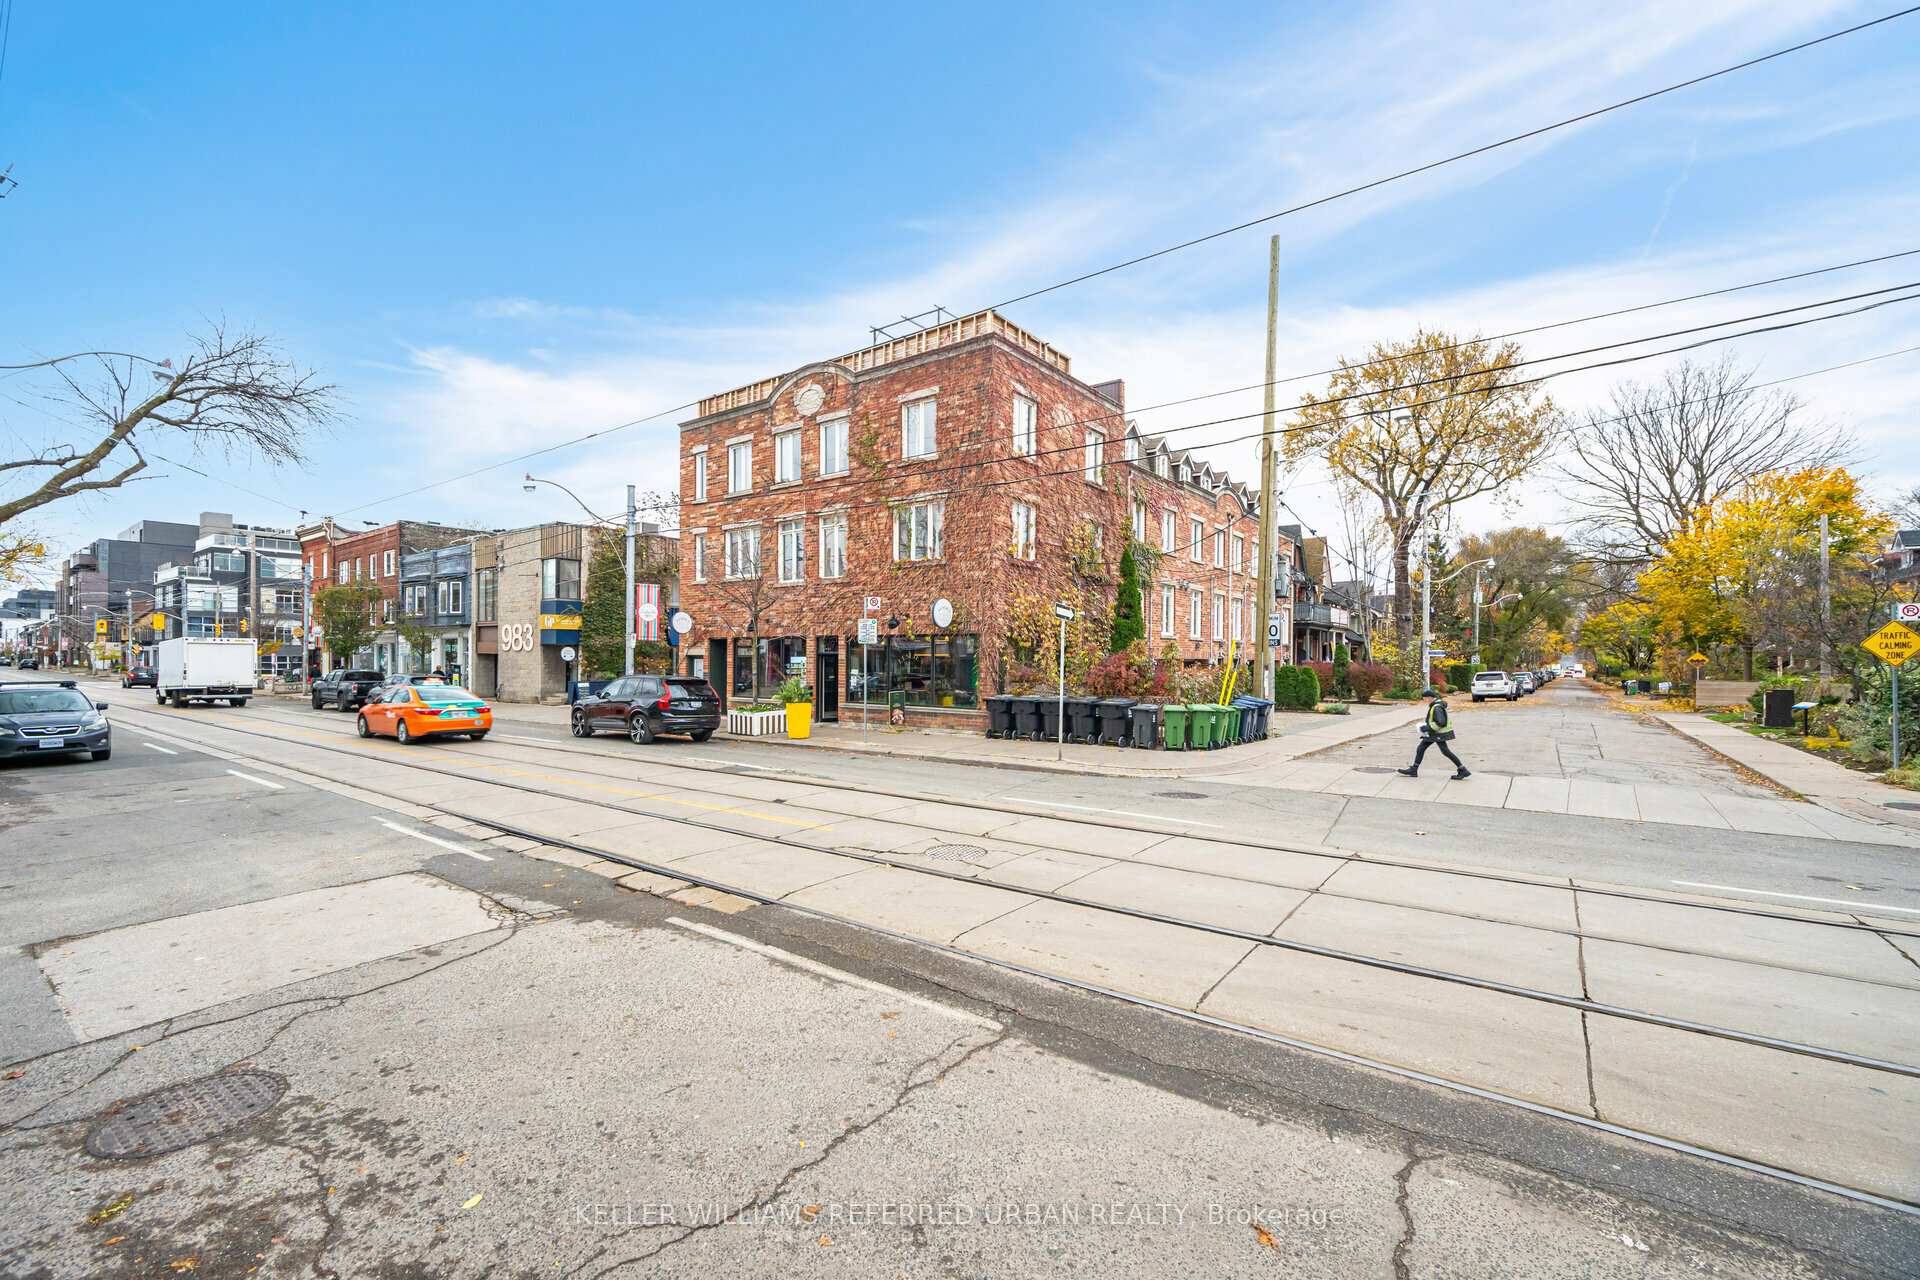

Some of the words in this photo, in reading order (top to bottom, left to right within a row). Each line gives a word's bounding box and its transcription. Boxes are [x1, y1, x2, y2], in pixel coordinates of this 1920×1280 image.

[502, 623, 534, 652] 983
[1879, 631, 1911, 640] TRAFFIC
[1879, 641, 1912, 650] CALMING
[1886, 651, 1905, 660] ZONE
